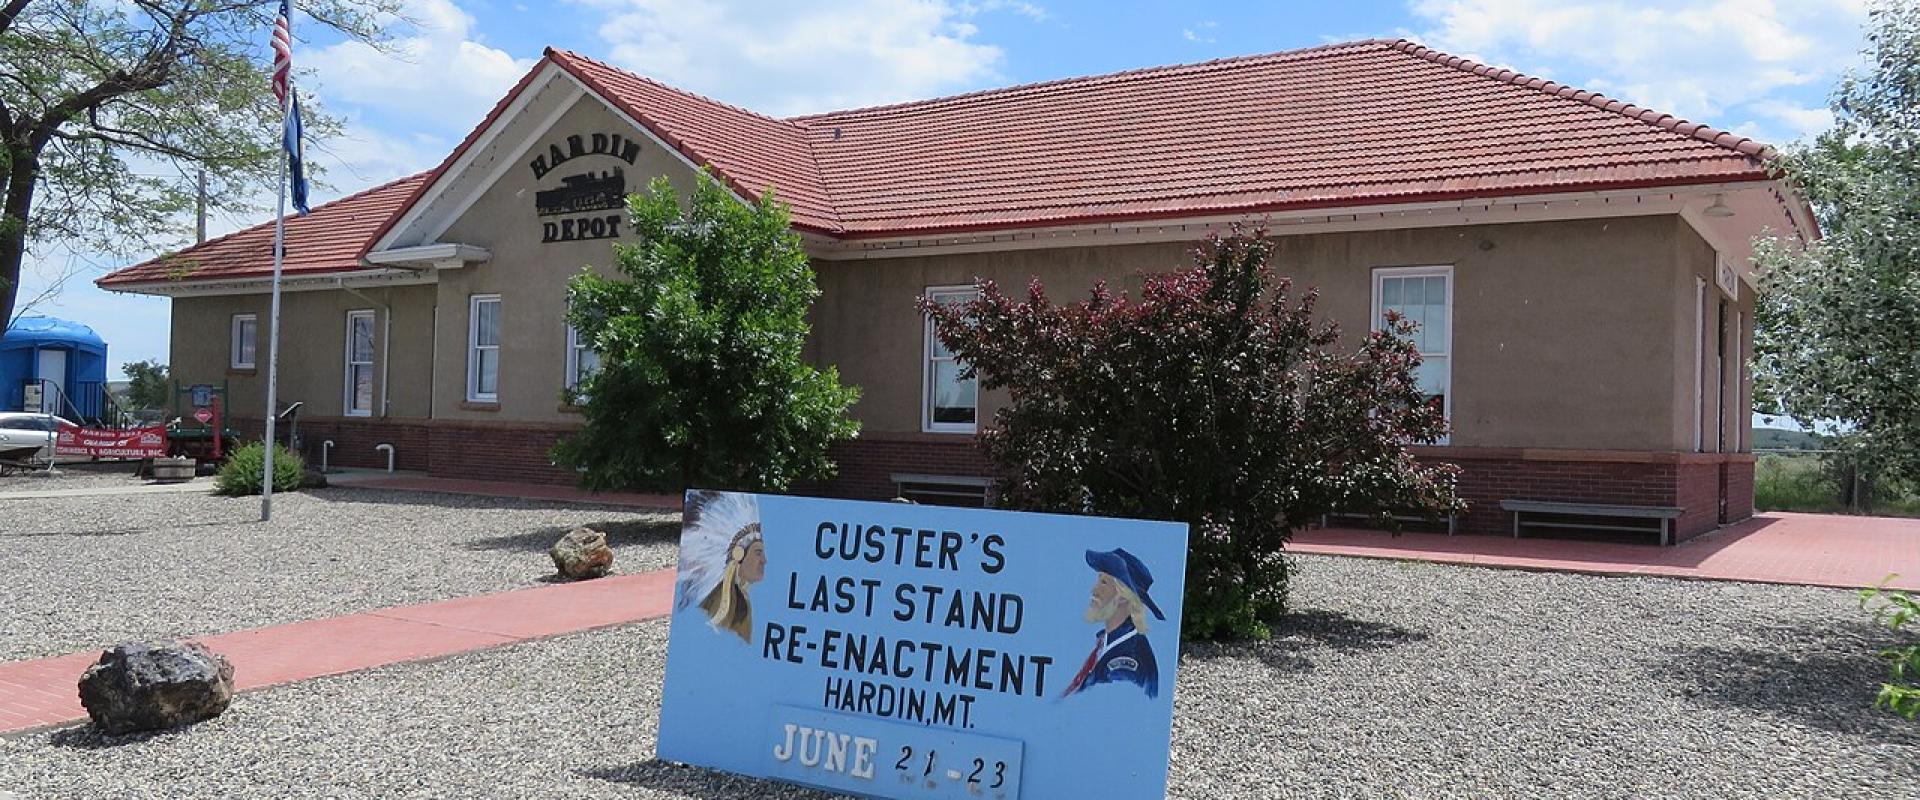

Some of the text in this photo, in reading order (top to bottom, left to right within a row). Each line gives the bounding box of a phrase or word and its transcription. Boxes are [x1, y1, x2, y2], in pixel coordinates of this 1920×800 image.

[532, 134, 640, 179] HARDIN
[542, 215, 622, 243] DEPOT
[814, 521, 1006, 574] CUSTER'S
[788, 571, 1024, 634] LAST STAND
[762, 622, 1053, 698] RE-ENACTMENT
[773, 723, 879, 780] JUNE
